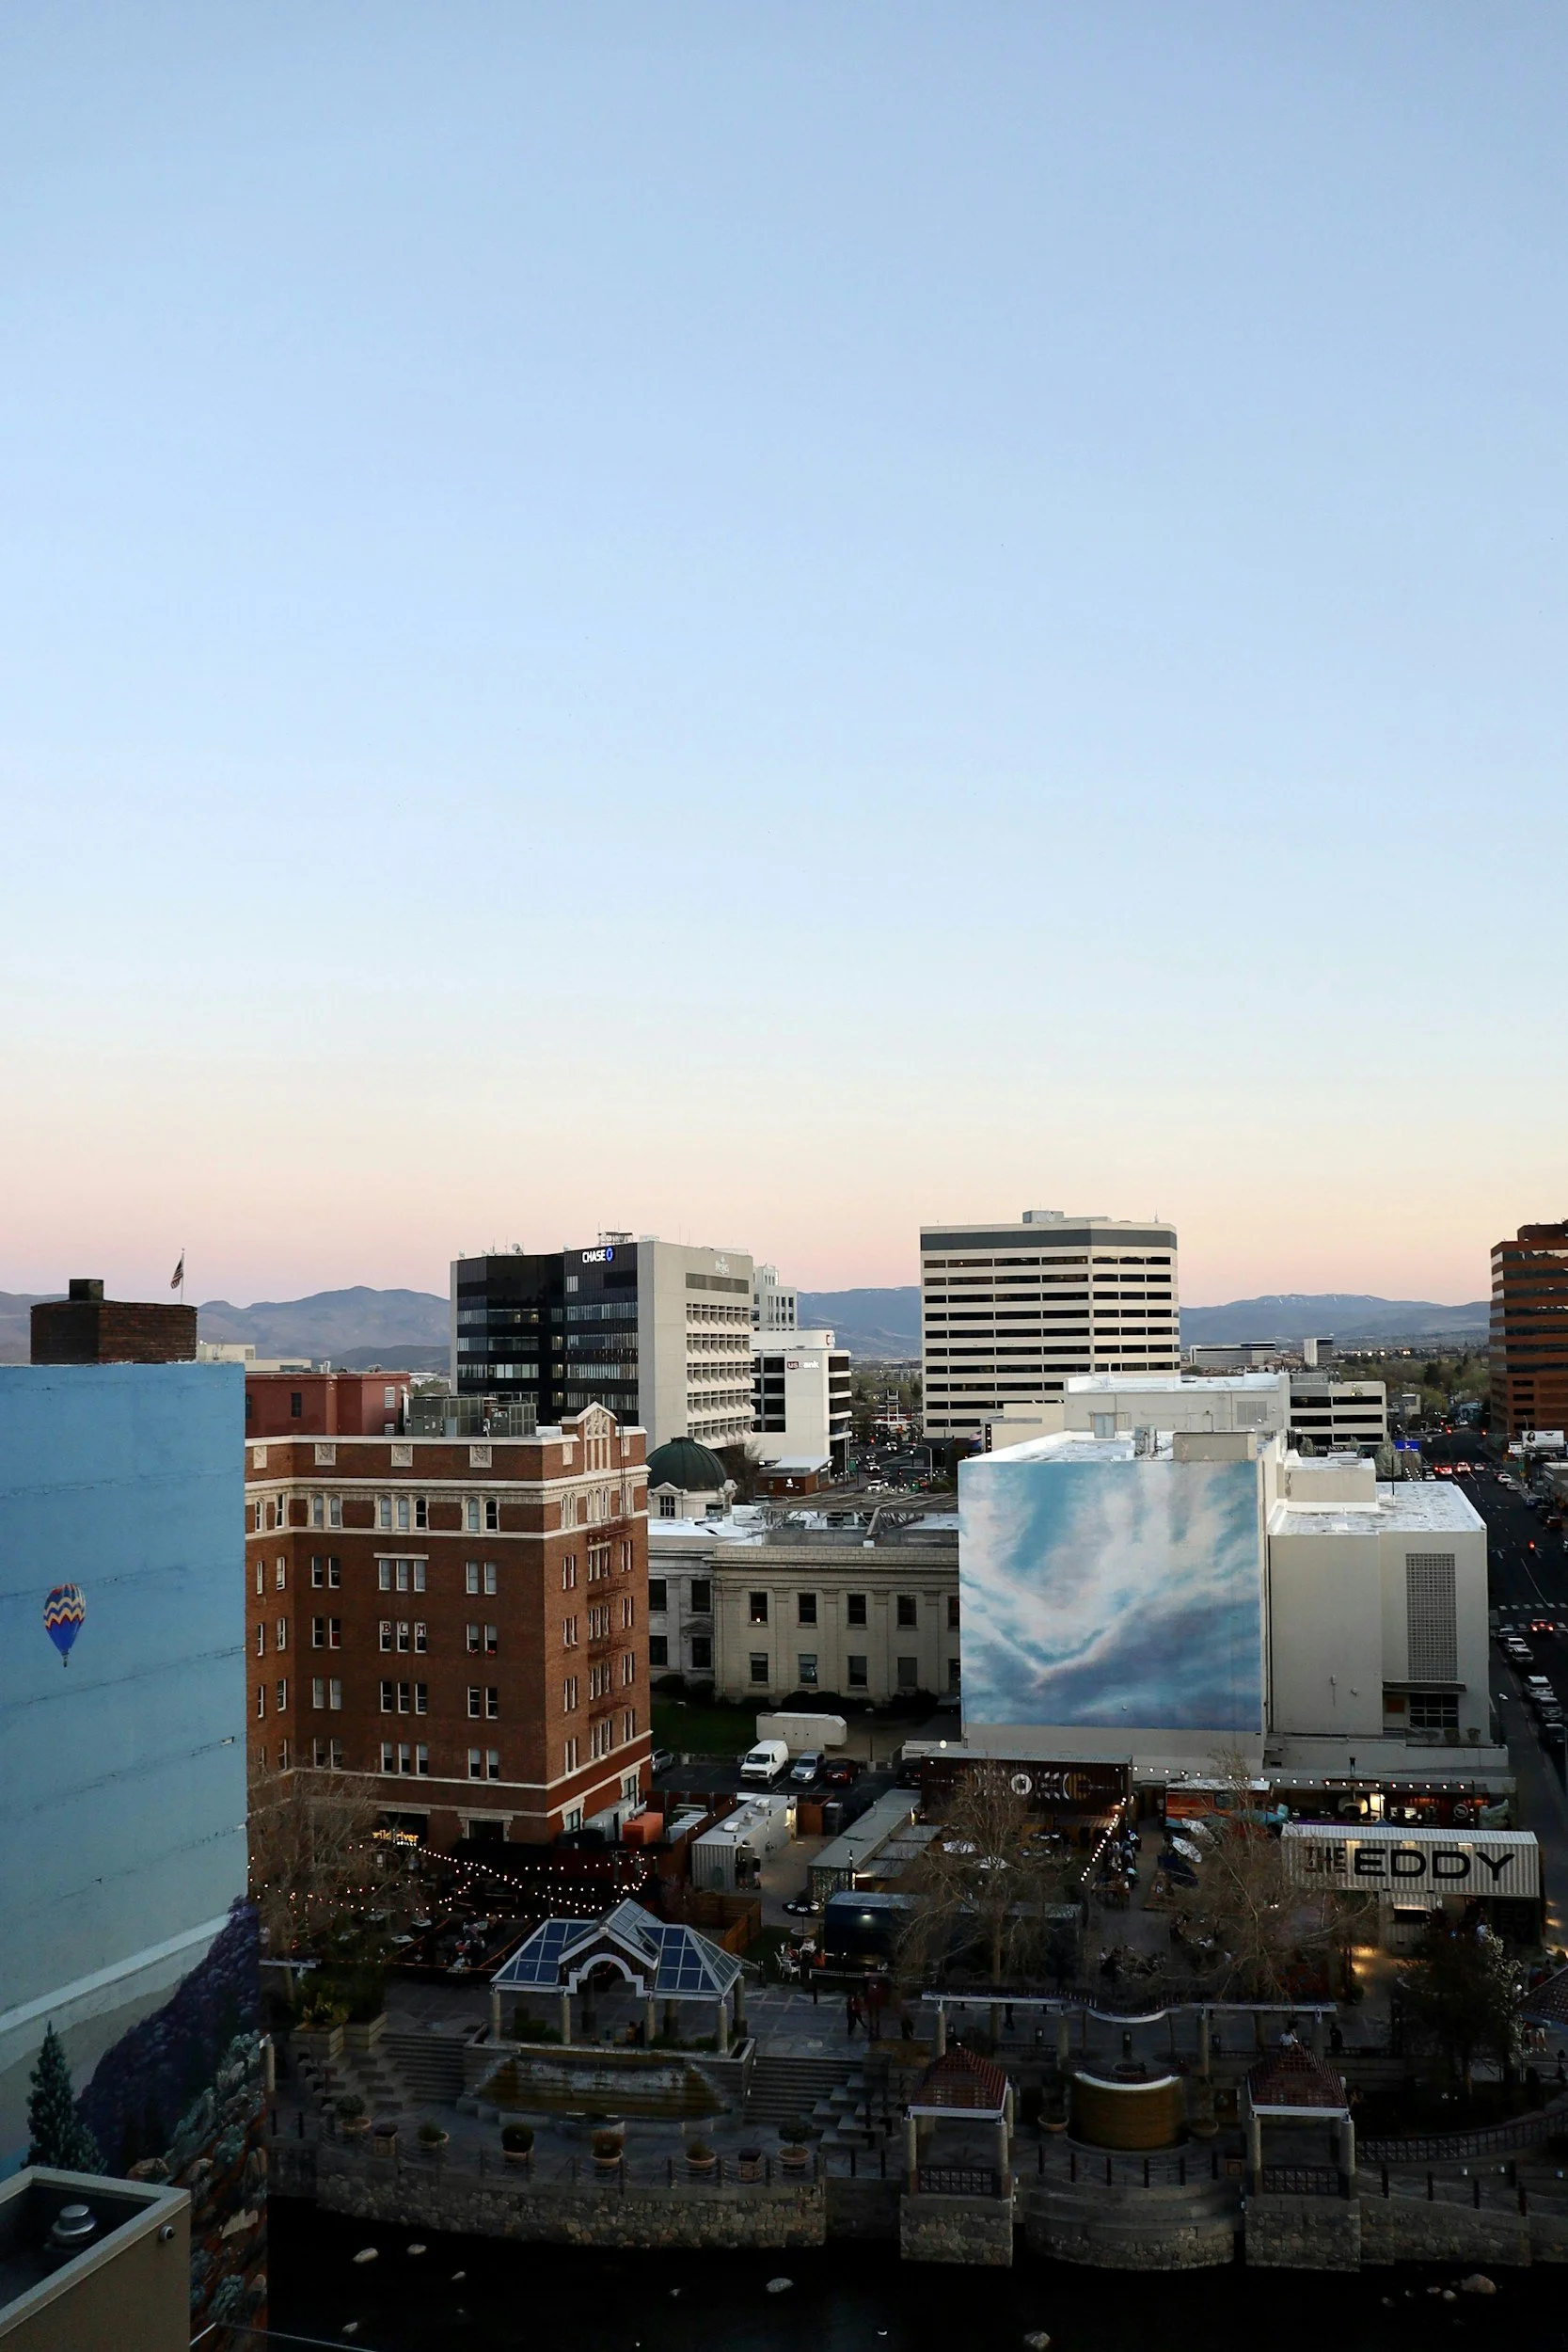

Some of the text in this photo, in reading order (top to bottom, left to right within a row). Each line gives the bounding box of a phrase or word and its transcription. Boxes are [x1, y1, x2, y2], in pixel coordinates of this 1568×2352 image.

[582, 1249, 606, 1263] CHASE
[396, 1831, 420, 1842] river
[1305, 1847, 1515, 1881] THE EDDY
